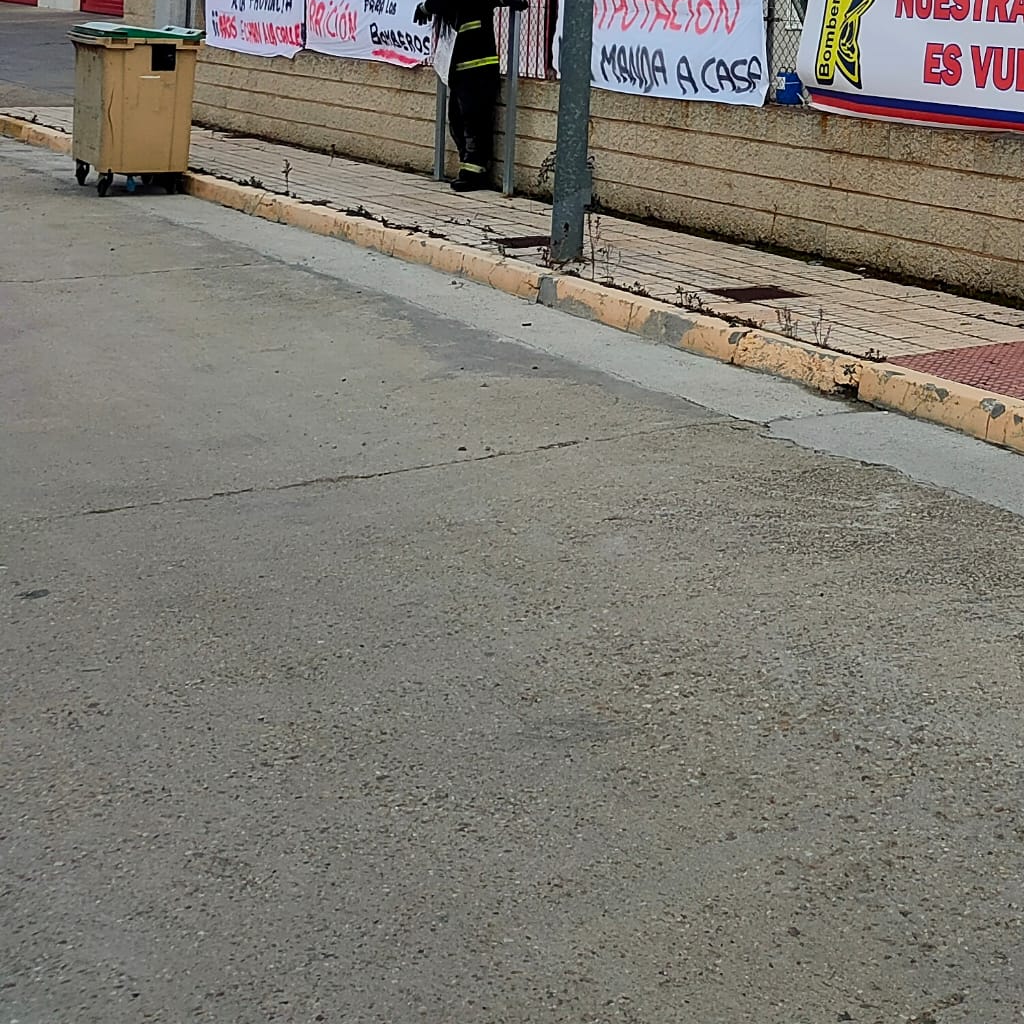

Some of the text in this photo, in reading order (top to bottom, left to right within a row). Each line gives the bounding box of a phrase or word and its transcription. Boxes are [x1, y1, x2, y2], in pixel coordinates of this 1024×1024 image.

[370, 22, 431, 55] BOMBEROS
[600, 44, 668, 93] MANDA
[676, 55, 699, 95] A
[701, 55, 762, 94] CASA
[923, 42, 963, 86] ES
